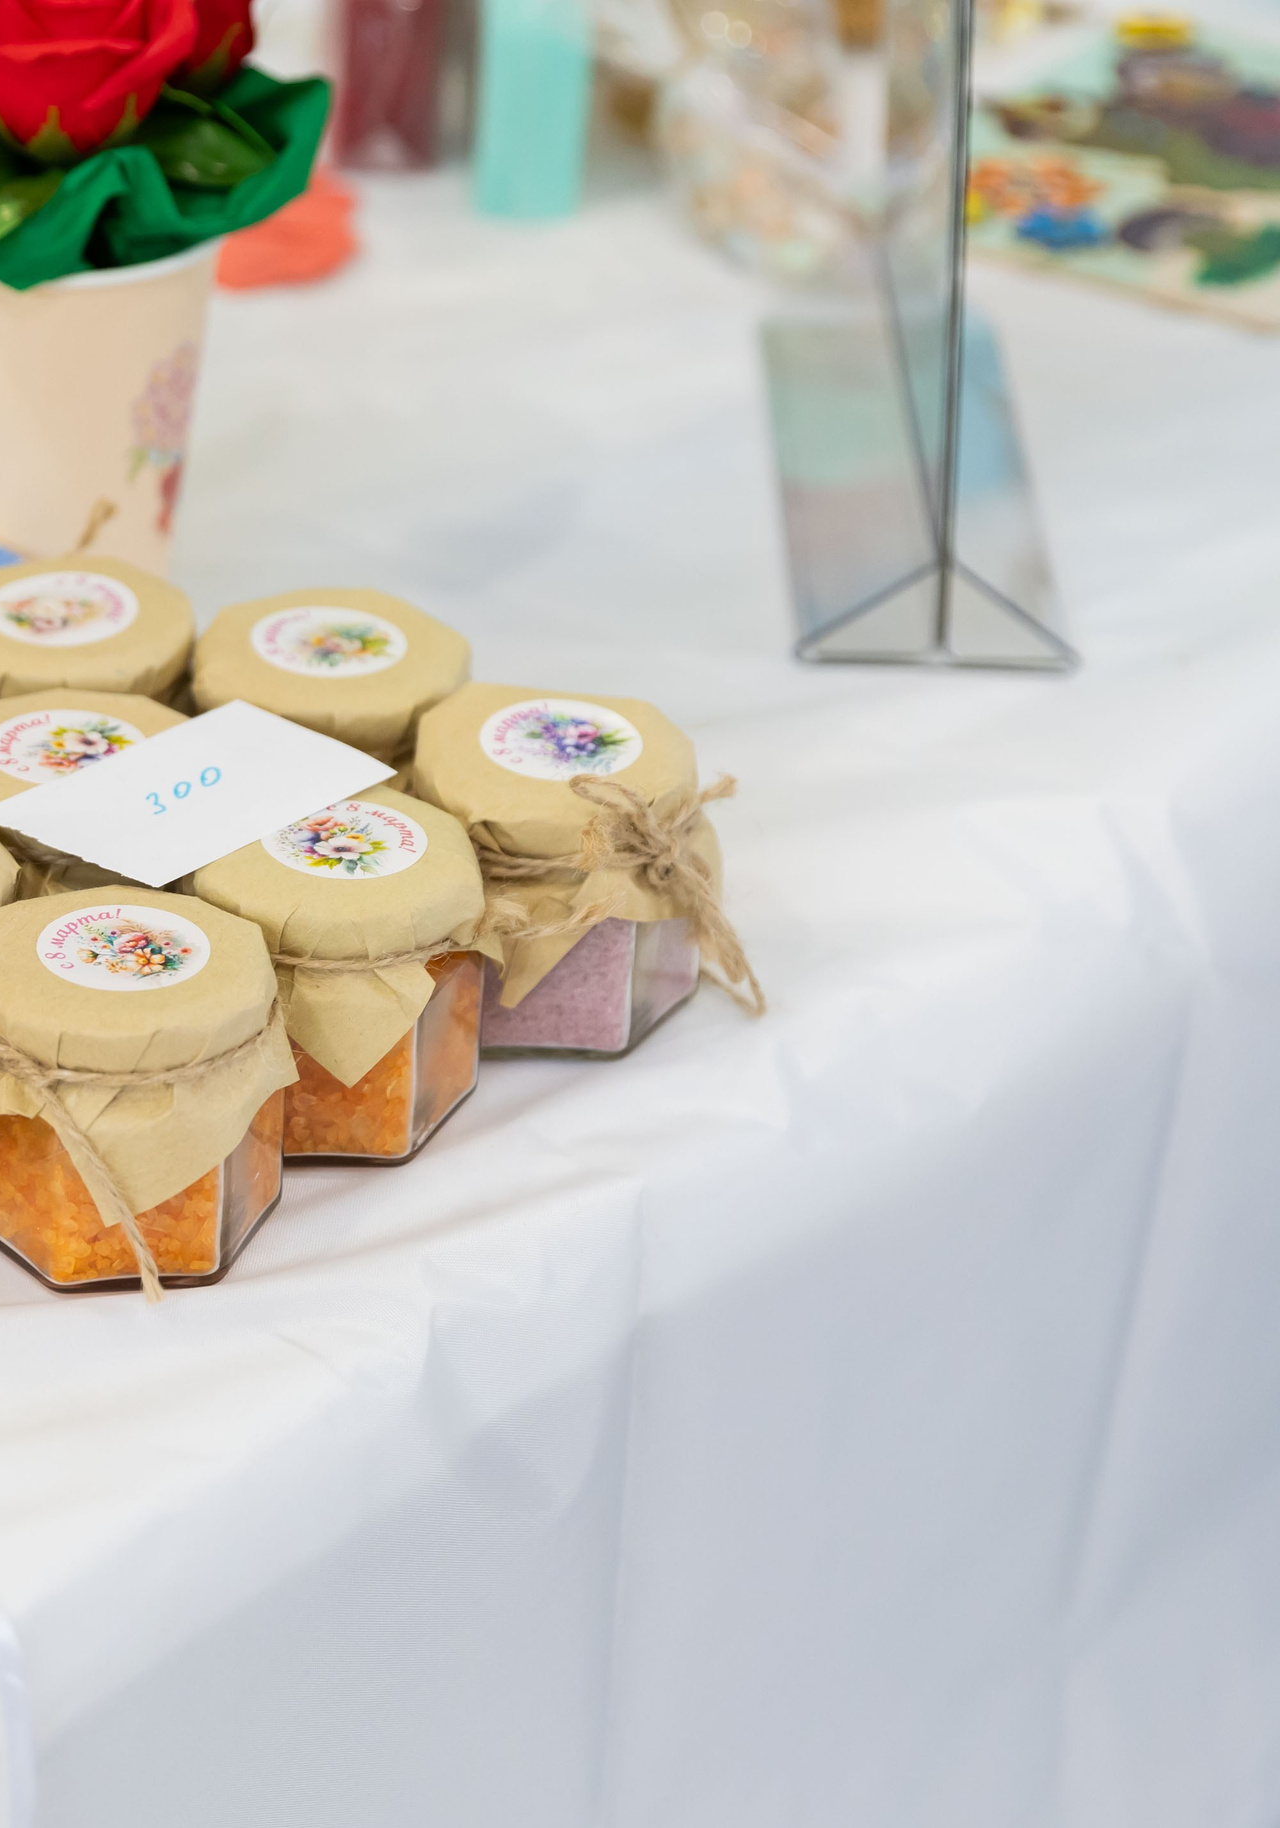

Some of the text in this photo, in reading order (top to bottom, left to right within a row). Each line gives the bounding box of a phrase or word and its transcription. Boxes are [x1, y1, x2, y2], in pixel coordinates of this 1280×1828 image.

[0, 714, 51, 755] марта!
[0, 758, 18, 766] 8
[145, 766, 222, 815] 300
[346, 803, 361, 812] 8
[365, 809, 417, 853] марта!
[50, 908, 122, 949] марта!
[45, 952, 66, 960] 8
